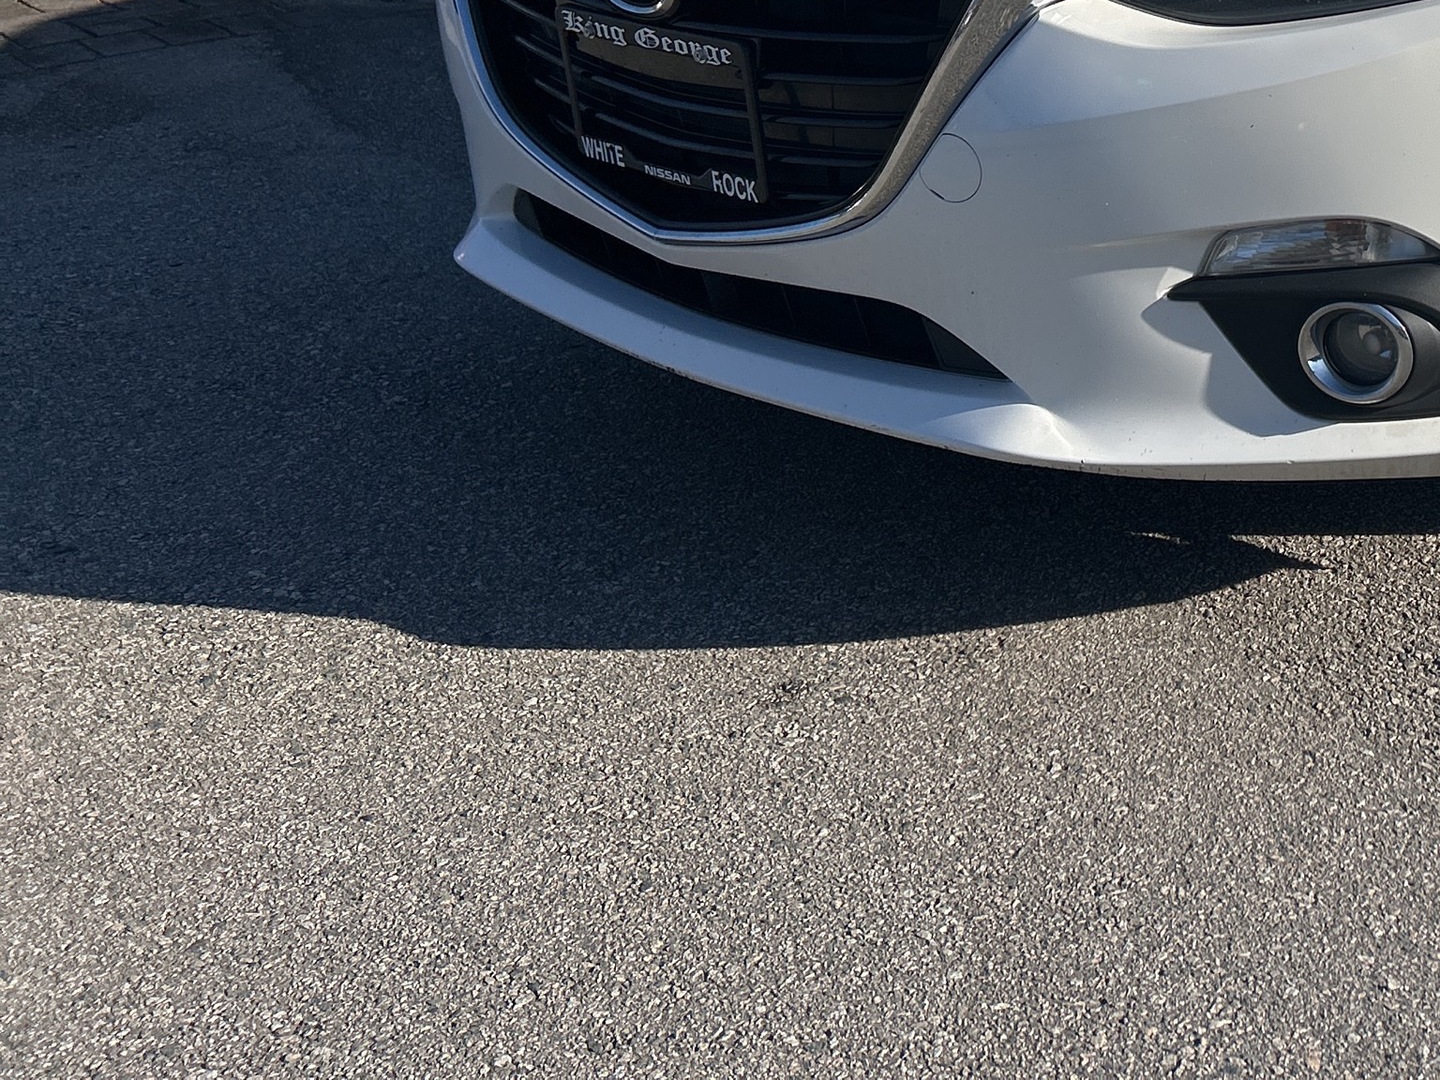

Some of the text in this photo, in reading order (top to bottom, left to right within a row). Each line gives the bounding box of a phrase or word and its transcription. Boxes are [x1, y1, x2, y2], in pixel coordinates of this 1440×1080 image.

[634, 27, 732, 66] George
[581, 135, 759, 203] WHITE NISSAN ROCK
